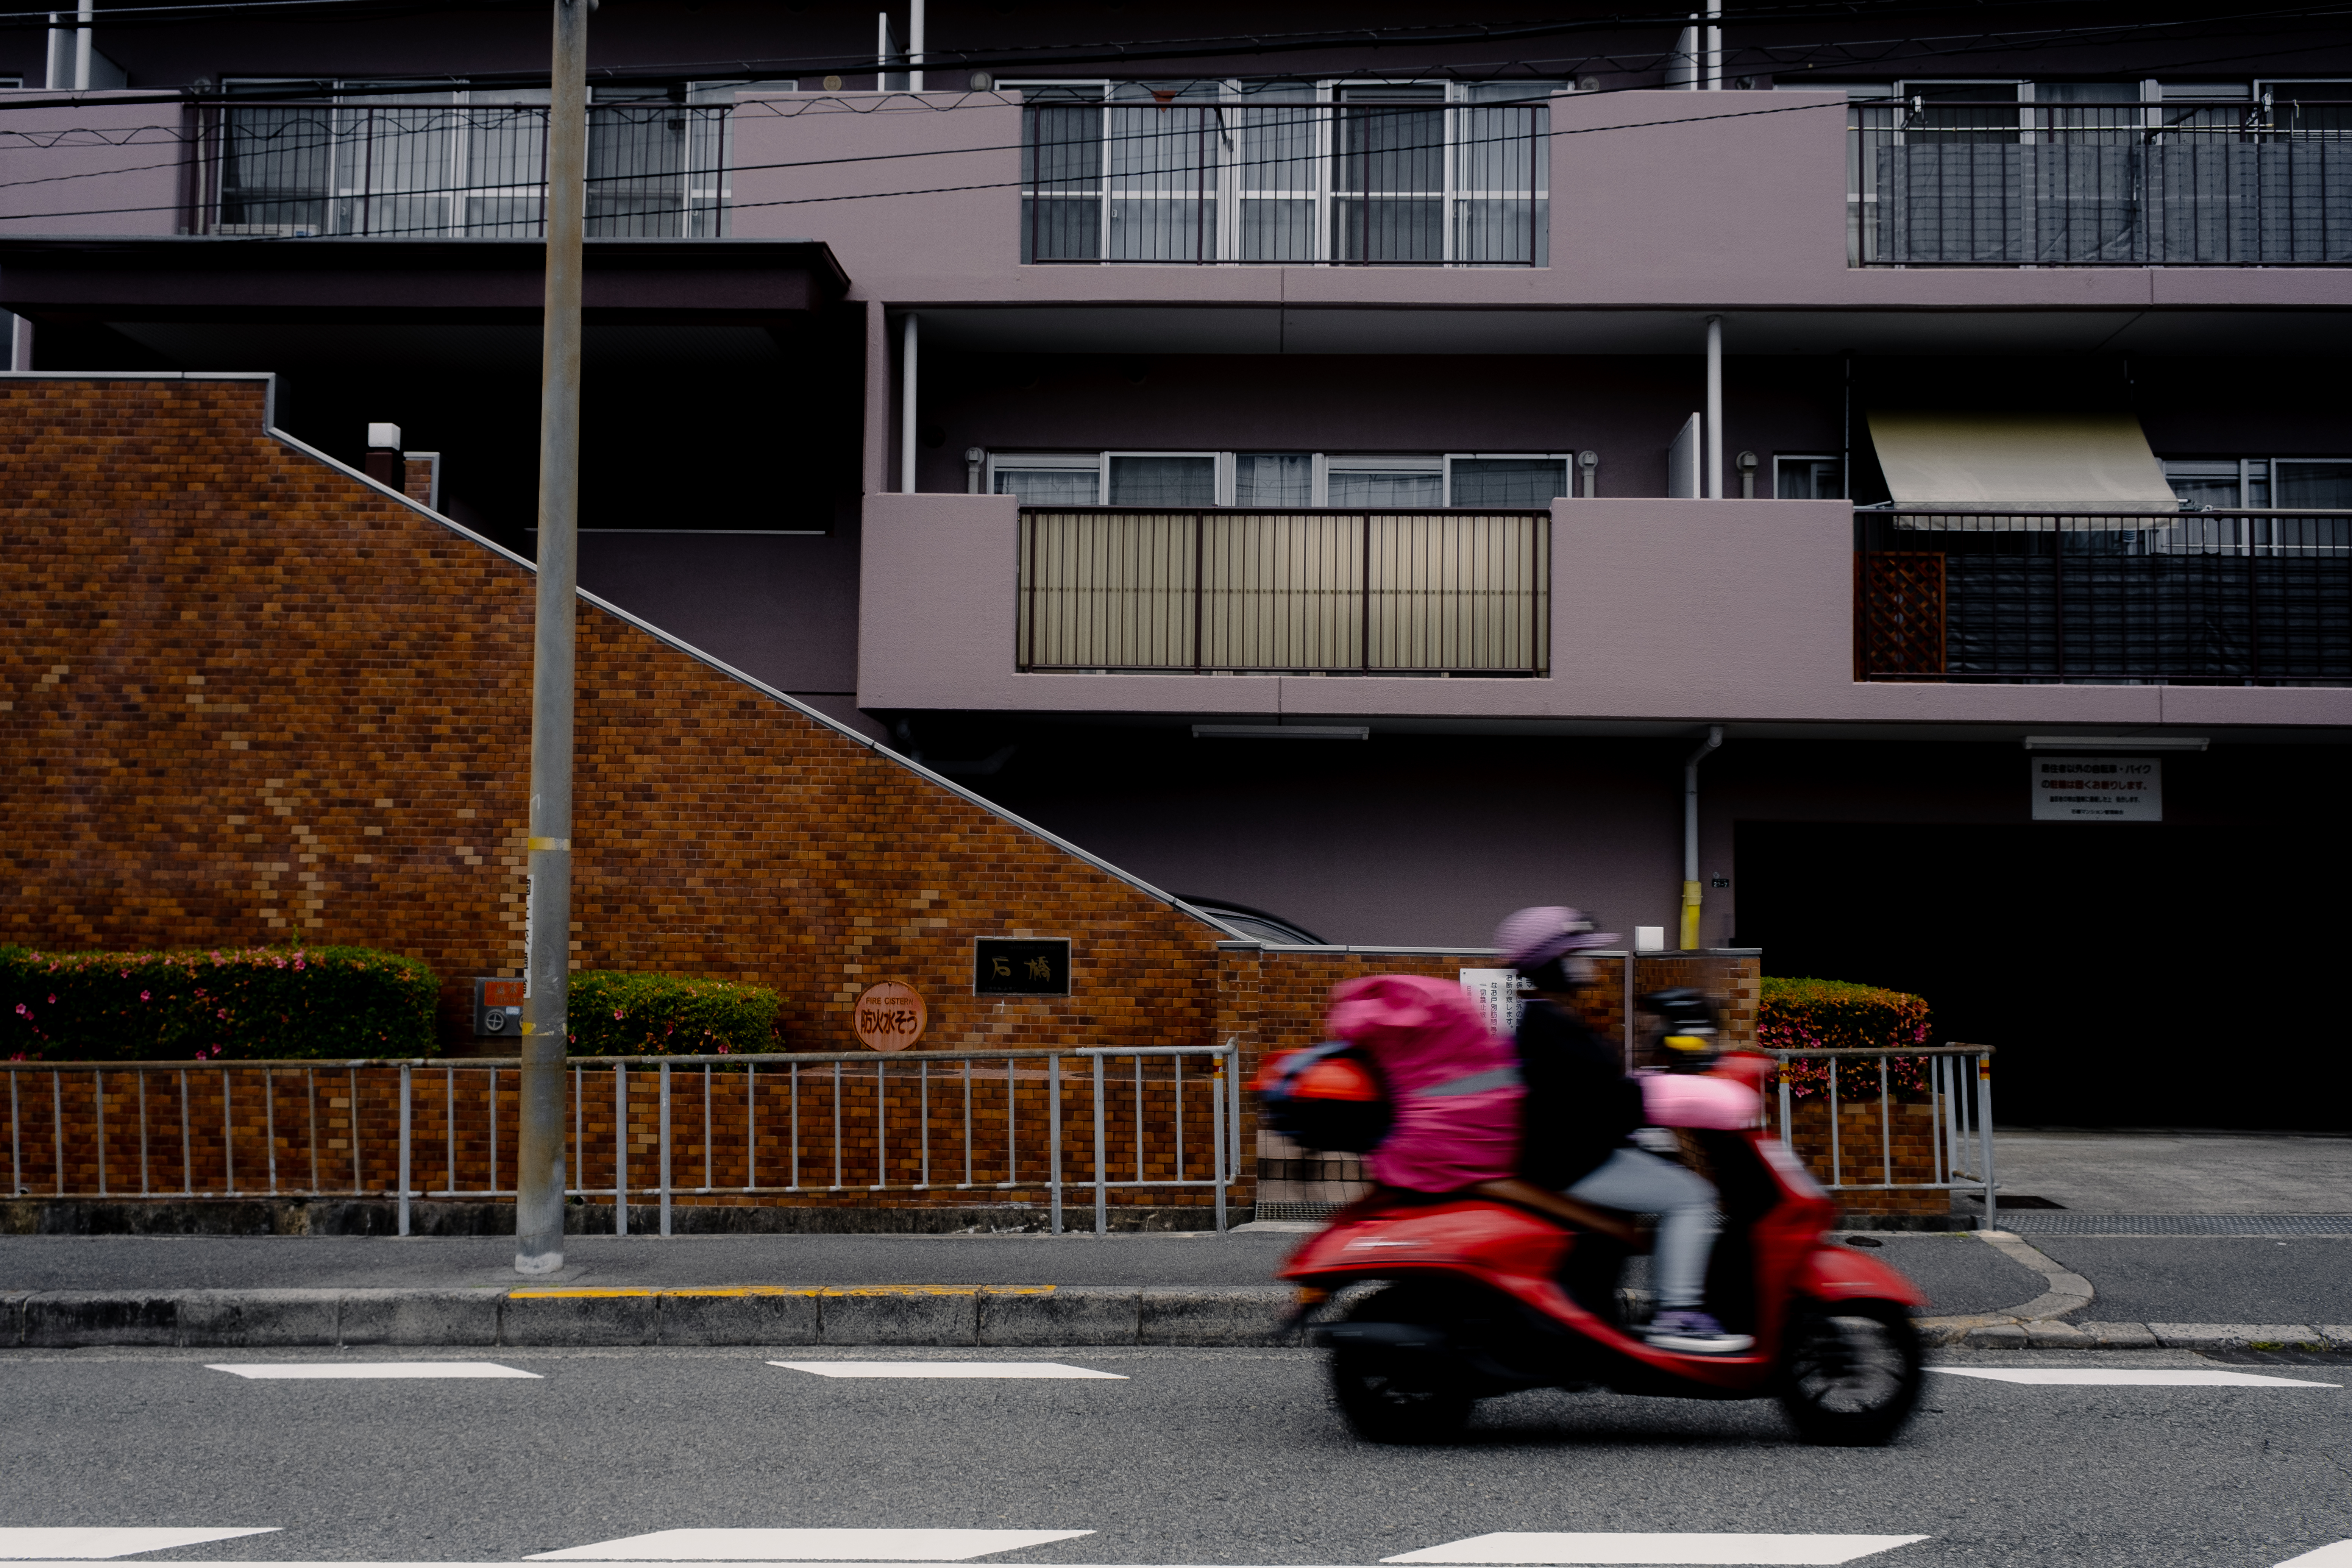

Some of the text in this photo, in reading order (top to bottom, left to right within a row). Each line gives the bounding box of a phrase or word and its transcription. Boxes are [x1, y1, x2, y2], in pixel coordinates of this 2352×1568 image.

[861, 1009, 918, 1034] 防火水そう
